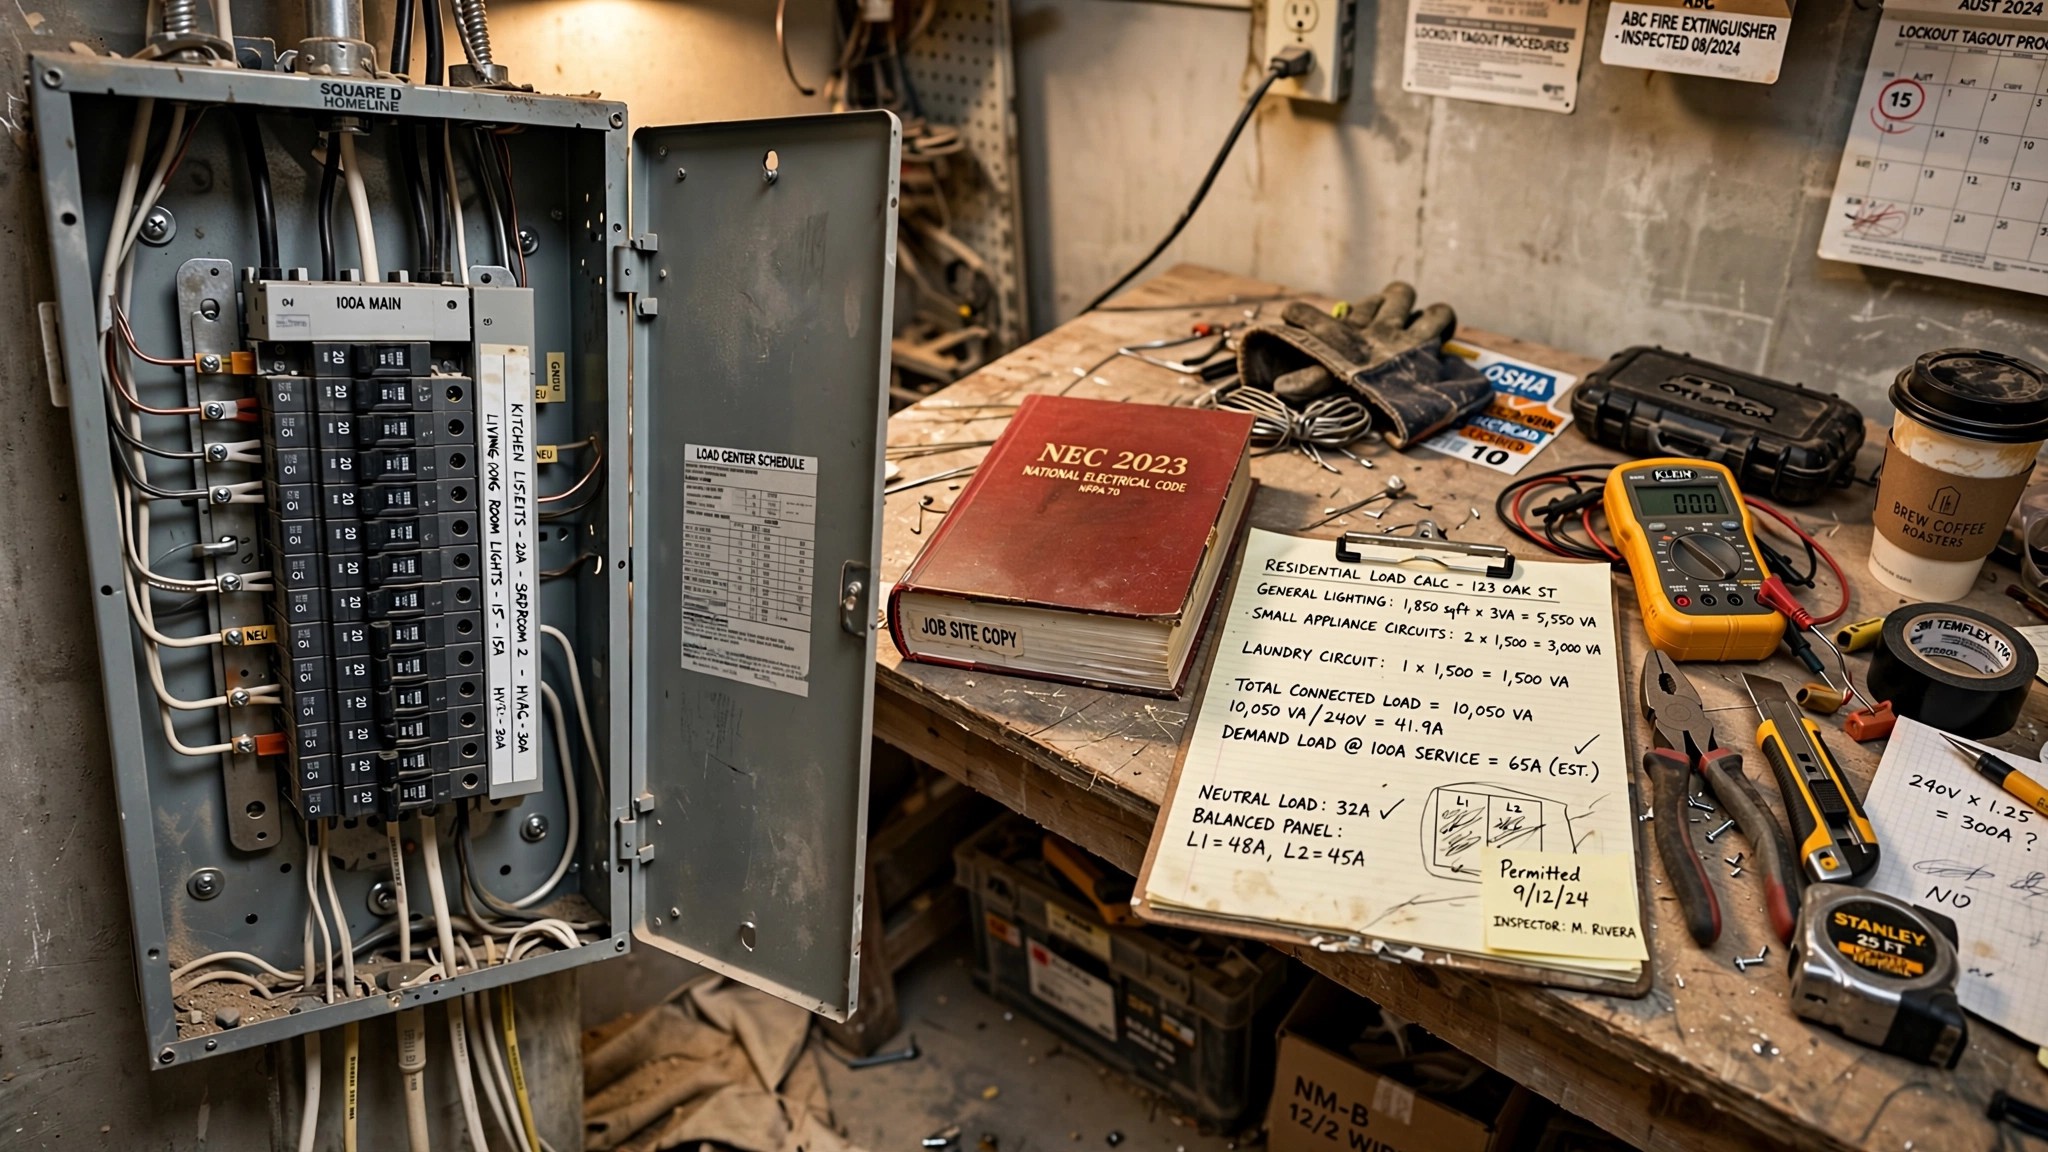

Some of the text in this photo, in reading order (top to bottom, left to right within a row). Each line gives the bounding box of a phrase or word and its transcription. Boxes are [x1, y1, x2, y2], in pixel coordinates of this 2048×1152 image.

[2002, 0, 2043, 16] 2024
[1621, 11, 1778, 41] ABC FIRE EXTINGUISHER
[1898, 25, 1959, 41] LOCKOUT
[1962, 30, 2016, 48] TAGOUT
[1415, 26, 1569, 54] LOCKOUT TAGOUT PROCEDURES
[1621, 29, 1741, 56] INSPECTED 08/2024
[320, 82, 402, 101] SQUARE D
[1890, 91, 1912, 108] 15
[324, 96, 399, 112] HOMELINE
[2023, 140, 2034, 150] 10
[336, 296, 401, 310] 100A MAIN
[333, 351, 344, 363] 20
[335, 386, 346, 398] 20
[1484, 365, 1550, 396] OSHA
[338, 422, 349, 434] 20
[511, 404, 525, 462] KITCHEN
[340, 458, 351, 470] 20
[696, 448, 806, 471] LOAD CENTER SCHEDULE
[1036, 442, 1189, 476] NEC 2023
[1470, 446, 1510, 466] 10
[1022, 465, 1188, 493] NATIONAL ELECTRICAL CODE
[1654, 470, 1693, 480] KLEIN
[343, 493, 354, 505] 20
[1107, 487, 1121, 496] 70
[489, 500, 501, 534] ROOM
[1893, 501, 1988, 536] BREW COFFEE
[345, 528, 356, 539] 20
[1902, 524, 1964, 548] ROASTERS
[348, 562, 358, 574] 20
[490, 542, 502, 586] LIGHTS
[1265, 558, 1361, 580] RESIDENTIAL
[1370, 570, 1406, 584] LOAD
[1413, 574, 1449, 589] CALC
[1472, 580, 1496, 593] 123
[1502, 584, 1532, 596] OAK
[1538, 586, 1558, 599] ST
[350, 597, 360, 608] 20
[1257, 582, 1318, 600] GENERAL
[1324, 590, 1394, 608] LIGHTING:
[1404, 598, 1439, 614] 1,850
[1444, 602, 1471, 620] sqft
[1490, 608, 1515, 621] 3VA
[1536, 612, 1574, 628] 5,550
[1580, 617, 1597, 628] VA
[246, 629, 269, 642] NEU
[352, 630, 363, 641] 20
[922, 616, 1018, 648] JOB SITE COPY
[1252, 607, 1298, 623] SMALL
[1304, 614, 1378, 632] APPLIANCE
[1384, 622, 1454, 640] CIRCUITS:
[1464, 632, 1474, 644] 2
[1495, 634, 1527, 650] 1,500
[1533, 640, 1542, 648] =
[1548, 640, 1582, 656] 3,000
[1586, 644, 1602, 656] VA
[1914, 619, 1994, 644] 3M TEMFLEX
[492, 636, 504, 656] 15A
[517, 648, 528, 658] 2
[354, 664, 365, 675] 20
[1242, 640, 1313, 662] LAUNDRY
[1319, 650, 1386, 668] CIRCUIT:
[1402, 660, 1408, 672] 1
[1434, 662, 1474, 680] 1,500
[1482, 670, 1492, 679] =
[1502, 670, 1542, 688] 1,500
[1550, 676, 1570, 688] VA
[356, 697, 366, 708] 20
[516, 685, 530, 720] HVAC
[1234, 678, 1534, 722] TOTAL CONNECTED LOAD = 10,050 VA
[1229, 700, 1281, 719] 10,050
[1374, 718, 1385, 727] =
[1394, 718, 1444, 736] 41.9A
[358, 729, 368, 739] 20
[518, 732, 529, 754] 30A
[360, 760, 370, 771] 20
[1222, 724, 1600, 784] DEMAND LOAD @ 100A SERVICE = 65A (EST.)
[362, 792, 372, 802] 20
[1198, 784, 1370, 818] NEUTRAL LOAD: 32A
[1456, 796, 1470, 808] L1
[1506, 802, 1523, 814] L2
[1908, 774, 1962, 801] 240V
[1990, 800, 2034, 823] 1.25
[1192, 807, 1343, 838] BALANCED PANEL:
[1936, 809, 2038, 852] = 300A ?
[1500, 858, 1581, 882] Permitted
[1513, 882, 1589, 910] 9/12/24
[1925, 885, 1972, 910] NO
[1493, 916, 1637, 938] INSPECTOR: M. RIVERA
[1834, 912, 1926, 947] STANLEY
[1856, 933, 1906, 955] 25 FT
[1294, 1075, 1369, 1128] NM-B
[1290, 1103, 1340, 1142] 12/2
